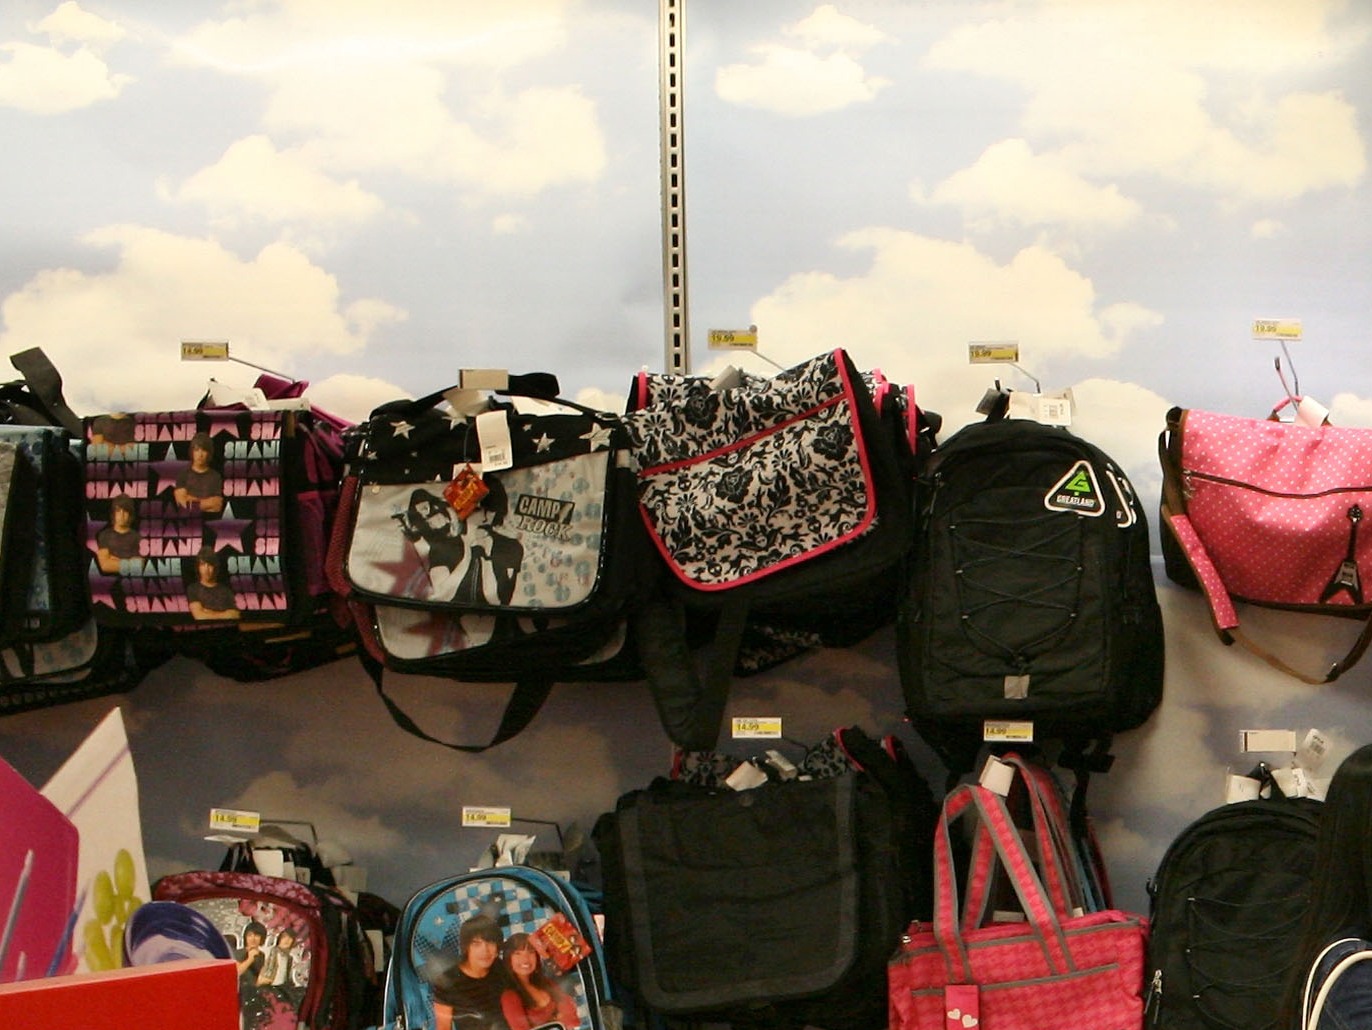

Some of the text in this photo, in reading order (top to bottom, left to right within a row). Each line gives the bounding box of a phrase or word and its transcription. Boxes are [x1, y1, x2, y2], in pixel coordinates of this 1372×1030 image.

[134, 418, 197, 441] SHANE
[519, 496, 561, 520] CAMP
[516, 514, 574, 541] ROCK
